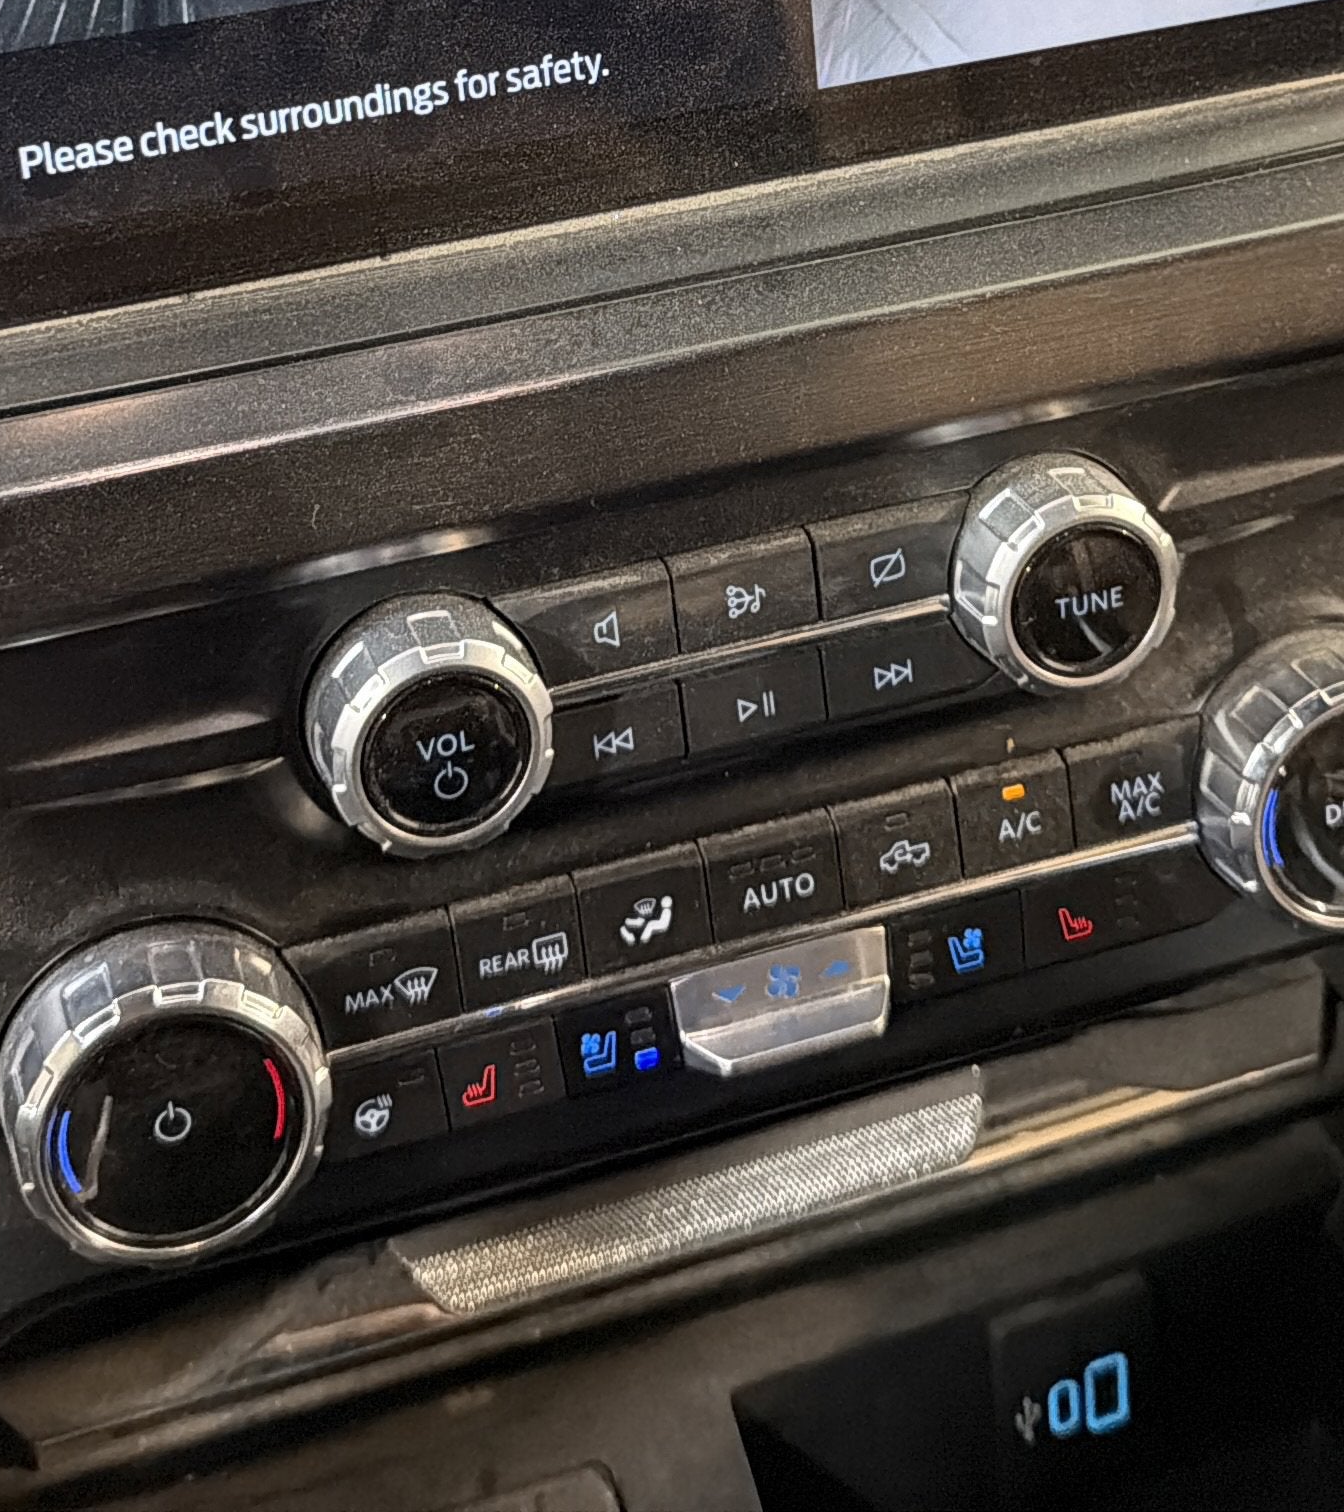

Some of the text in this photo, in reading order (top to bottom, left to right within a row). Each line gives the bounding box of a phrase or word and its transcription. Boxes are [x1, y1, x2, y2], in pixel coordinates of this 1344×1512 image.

[18, 51, 611, 180] Please check surroundings for safety.
[1055, 586, 1124, 620] TUNE
[417, 730, 475, 762] VOL
[1109, 771, 1166, 803] MAX
[1118, 794, 1162, 823] A/C
[997, 809, 1043, 842] A/C
[743, 872, 815, 911] AUTO
[478, 948, 530, 978] REAR
[345, 984, 395, 1013] MAX
